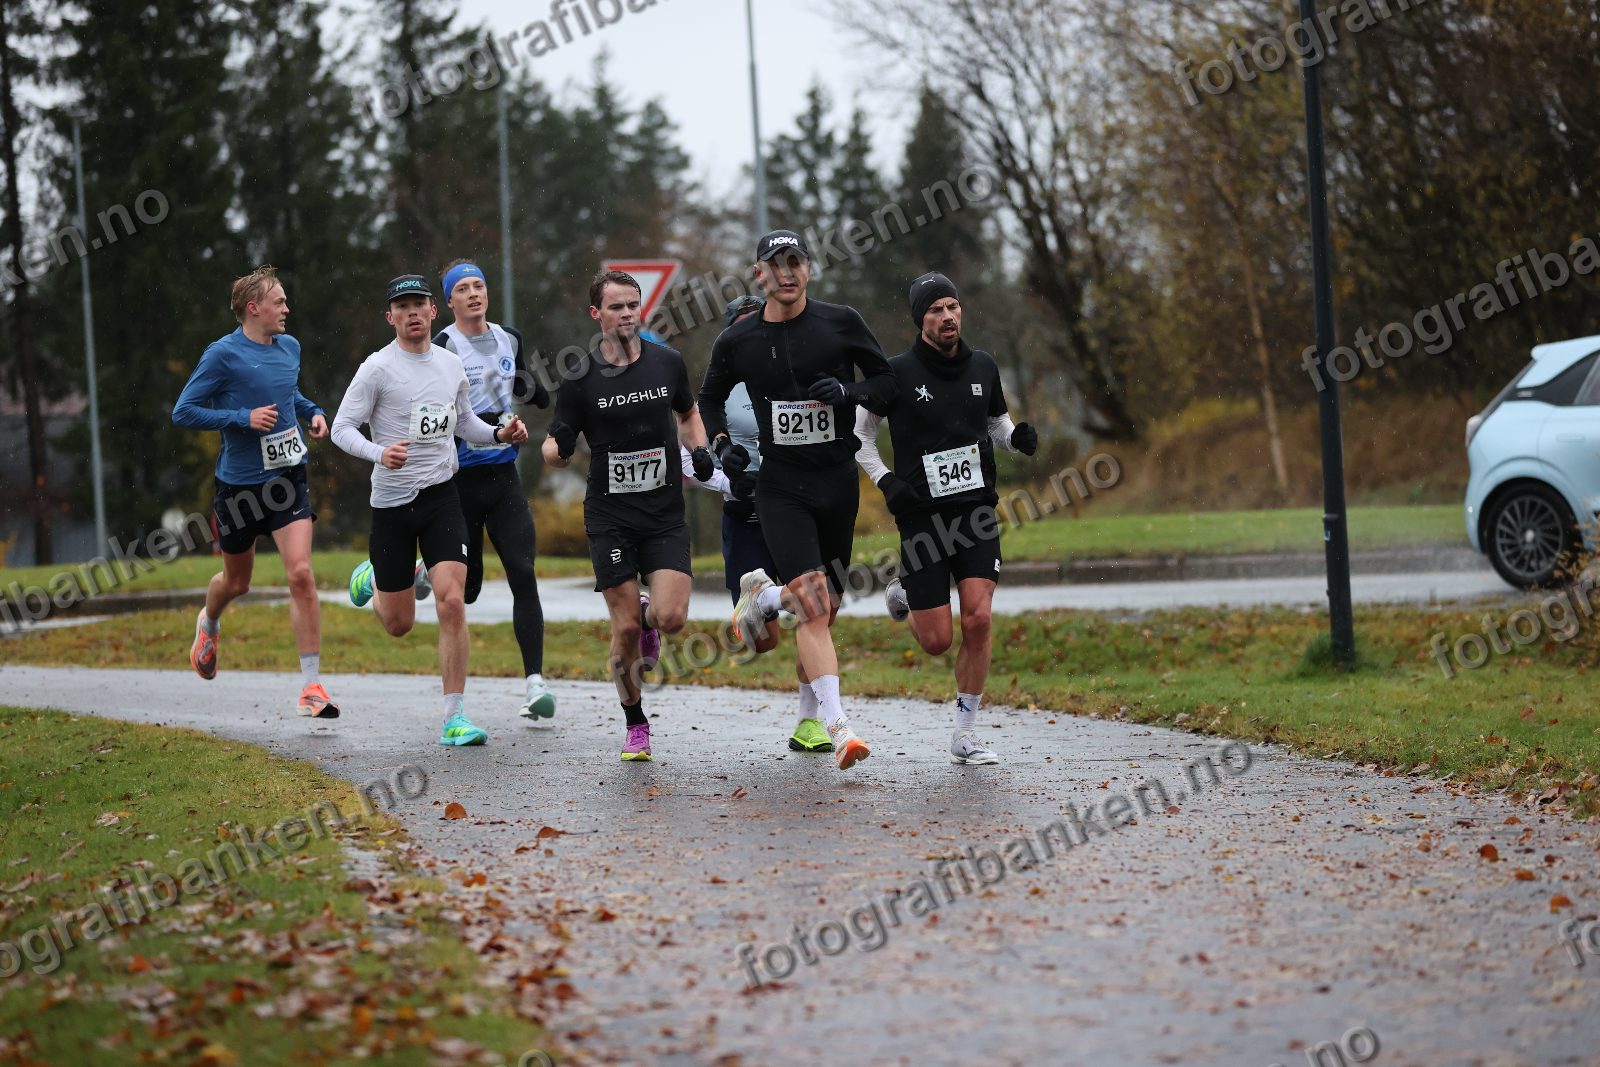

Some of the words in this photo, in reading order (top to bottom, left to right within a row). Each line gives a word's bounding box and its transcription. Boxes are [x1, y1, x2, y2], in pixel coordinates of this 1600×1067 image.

[769, 236, 798, 247] HOKA
[396, 280, 421, 291] HOKA
[420, 415, 449, 435] 614
[778, 410, 829, 434] 9218
[266, 436, 302, 461] 9478
[614, 449, 662, 461] NORGESTESTEN
[613, 458, 661, 483] 9177
[938, 459, 972, 486] 546
